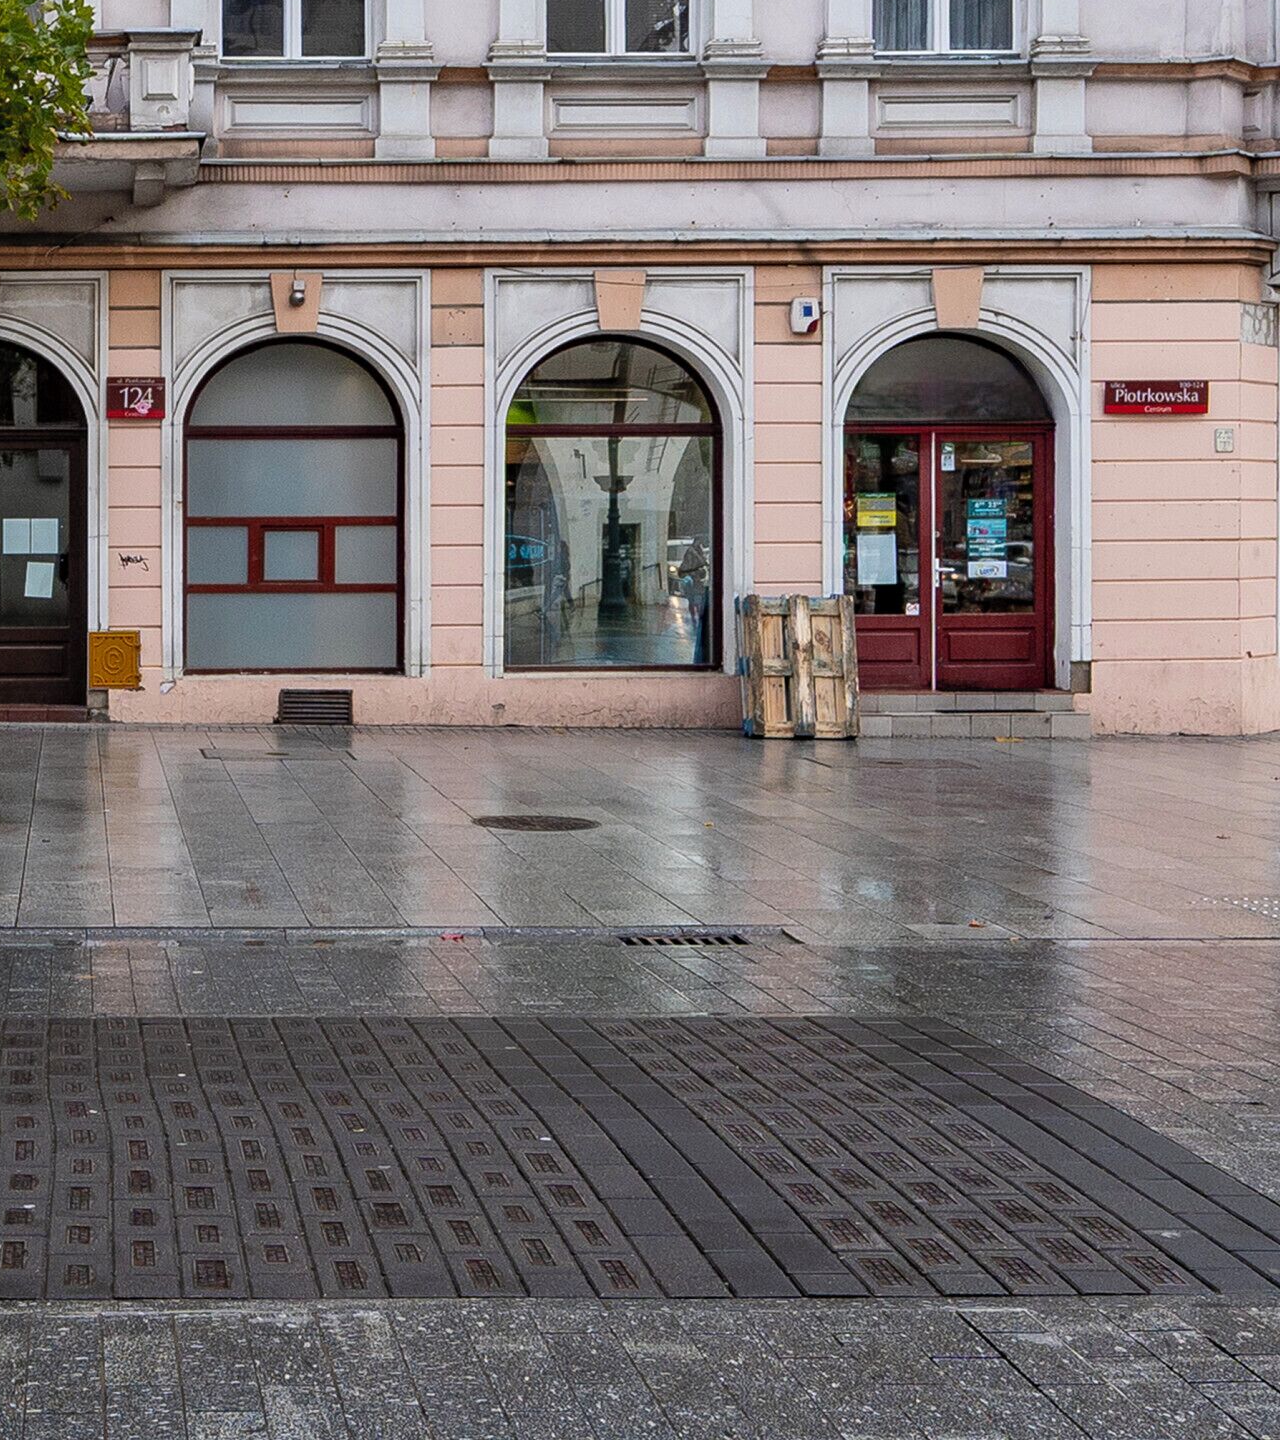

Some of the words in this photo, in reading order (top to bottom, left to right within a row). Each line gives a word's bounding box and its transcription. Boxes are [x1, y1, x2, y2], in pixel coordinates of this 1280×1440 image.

[119, 386, 154, 409] 124
[1115, 388, 1199, 403] Piotrkowska
[1144, 405, 1172, 413] Centrum
